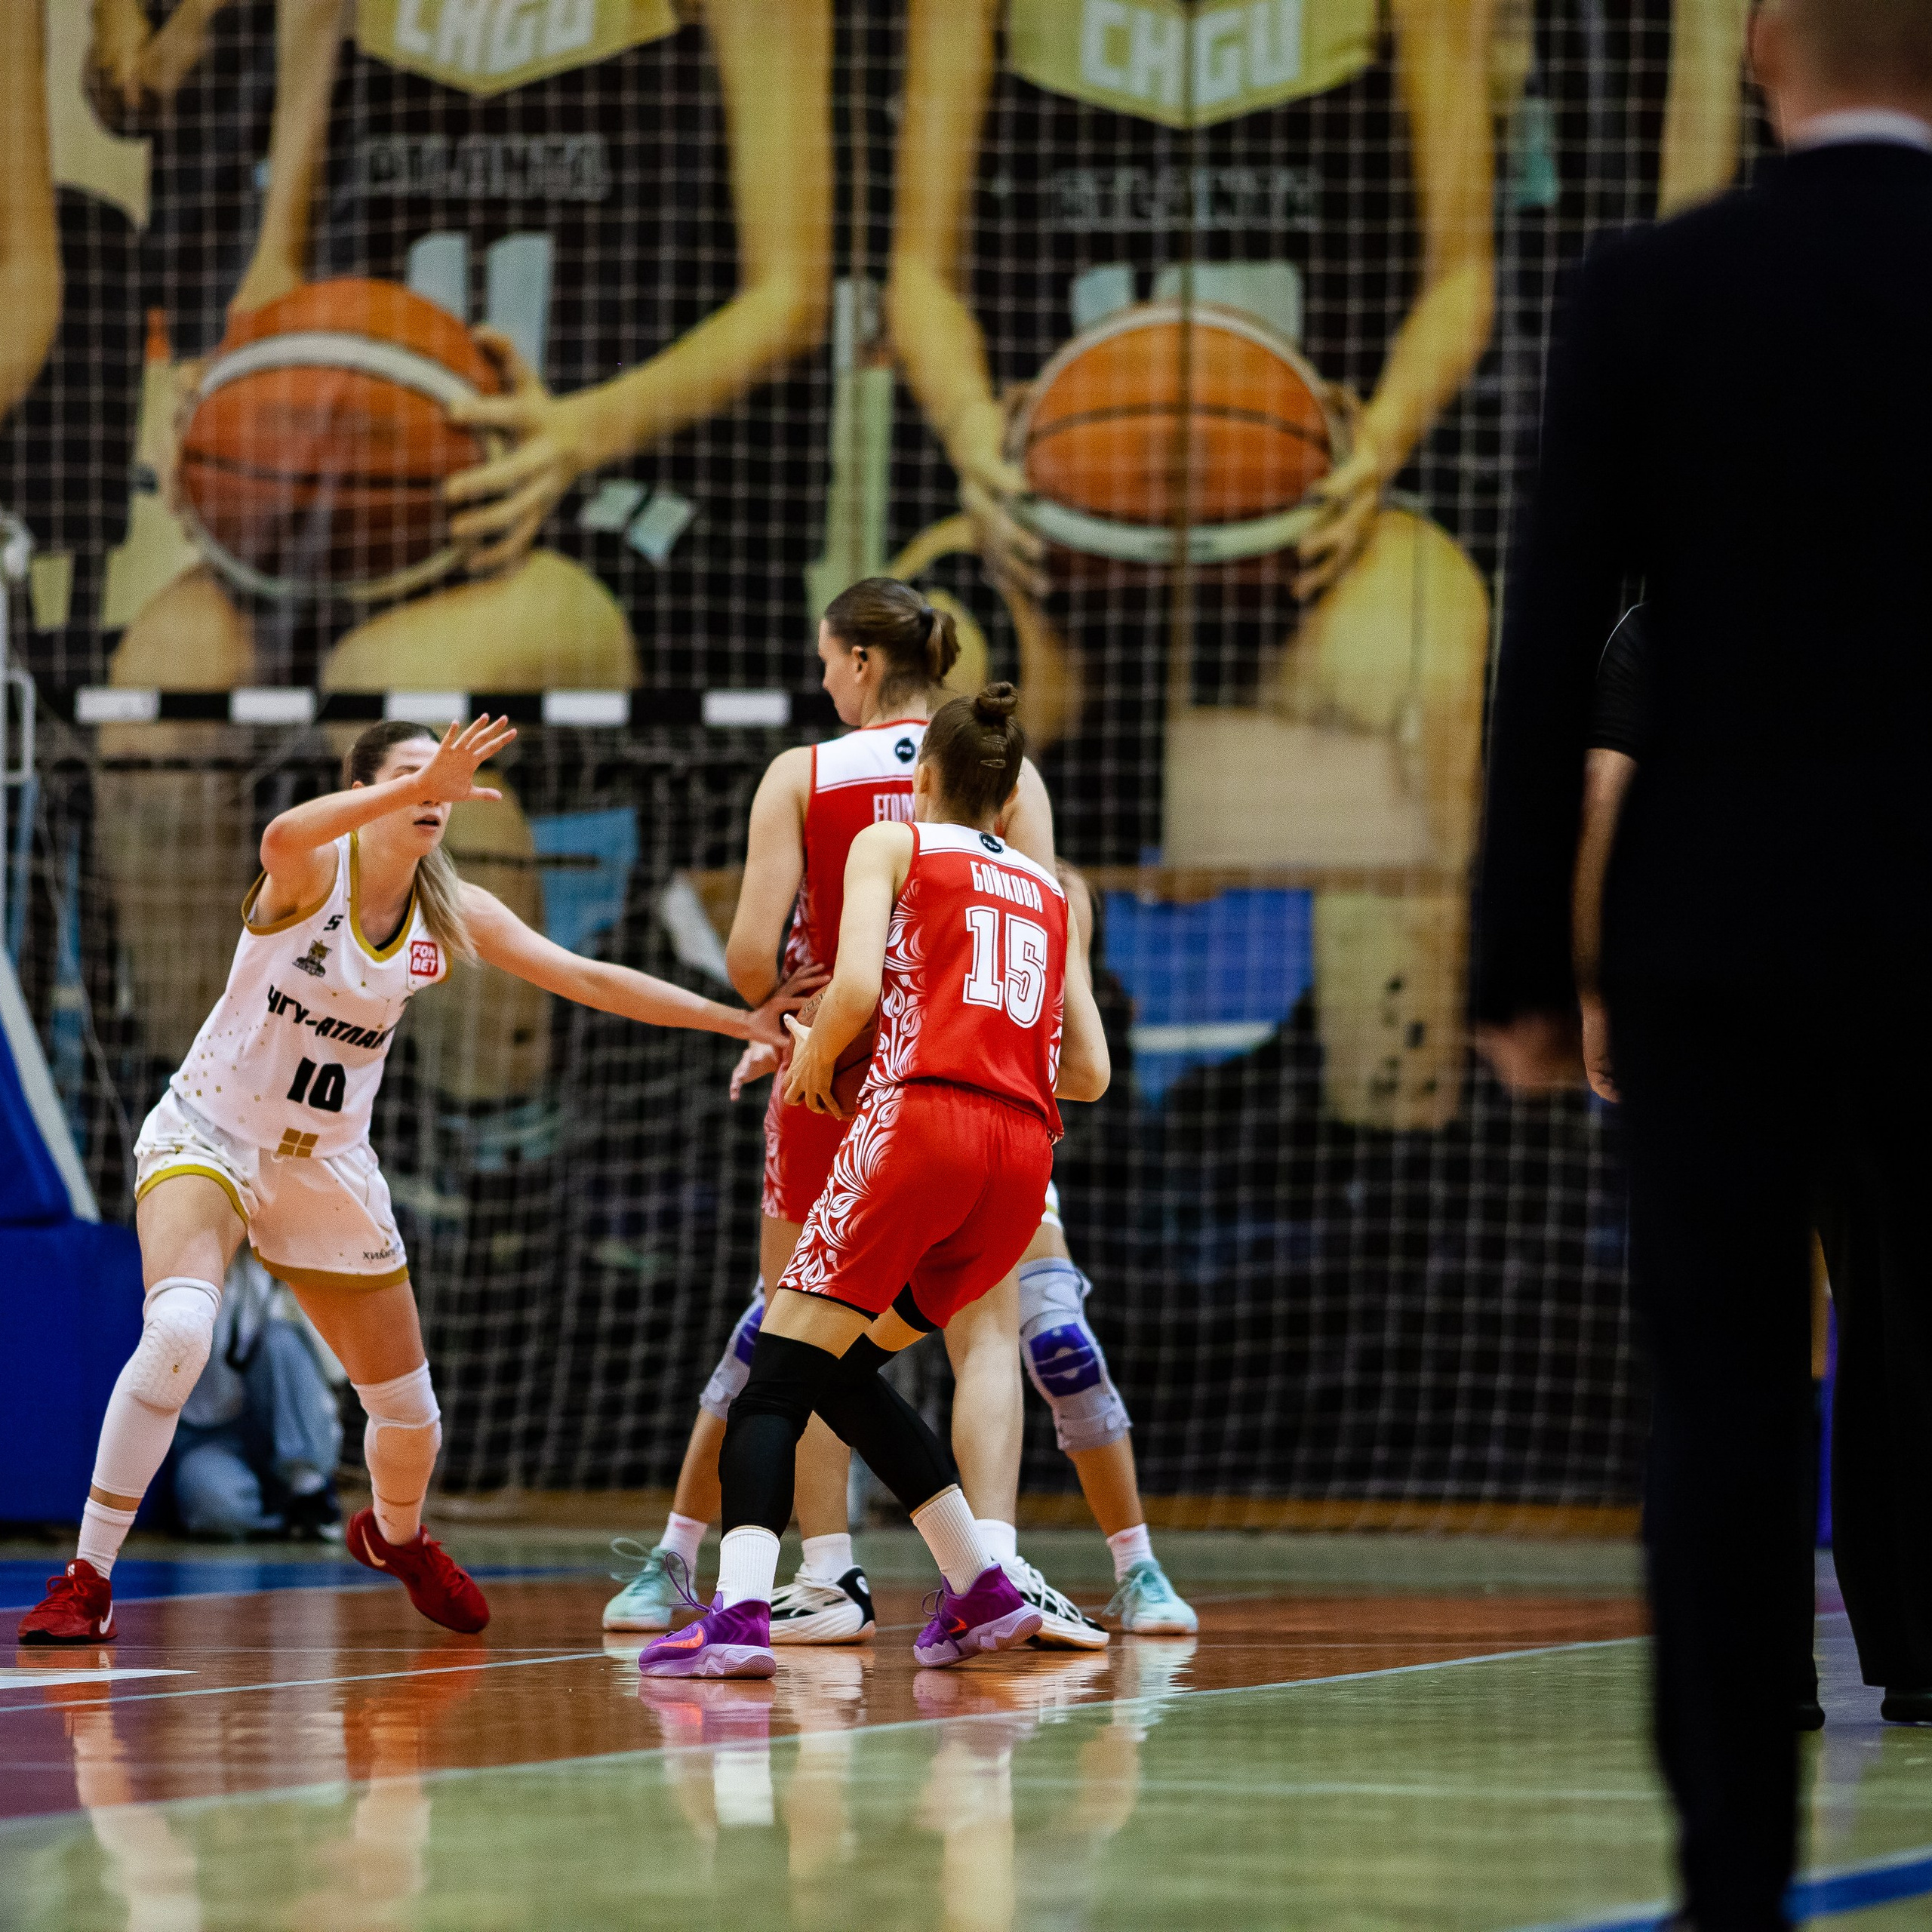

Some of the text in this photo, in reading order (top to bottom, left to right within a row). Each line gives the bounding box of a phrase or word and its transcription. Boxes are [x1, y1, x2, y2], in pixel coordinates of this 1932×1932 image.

[1081, 0, 1303, 106] CHGU
[970, 860, 1043, 913] БОЙКОВА
[412, 958, 437, 972] BET
[962, 905, 1048, 1029] 15
[286, 1057, 346, 1112] 10
